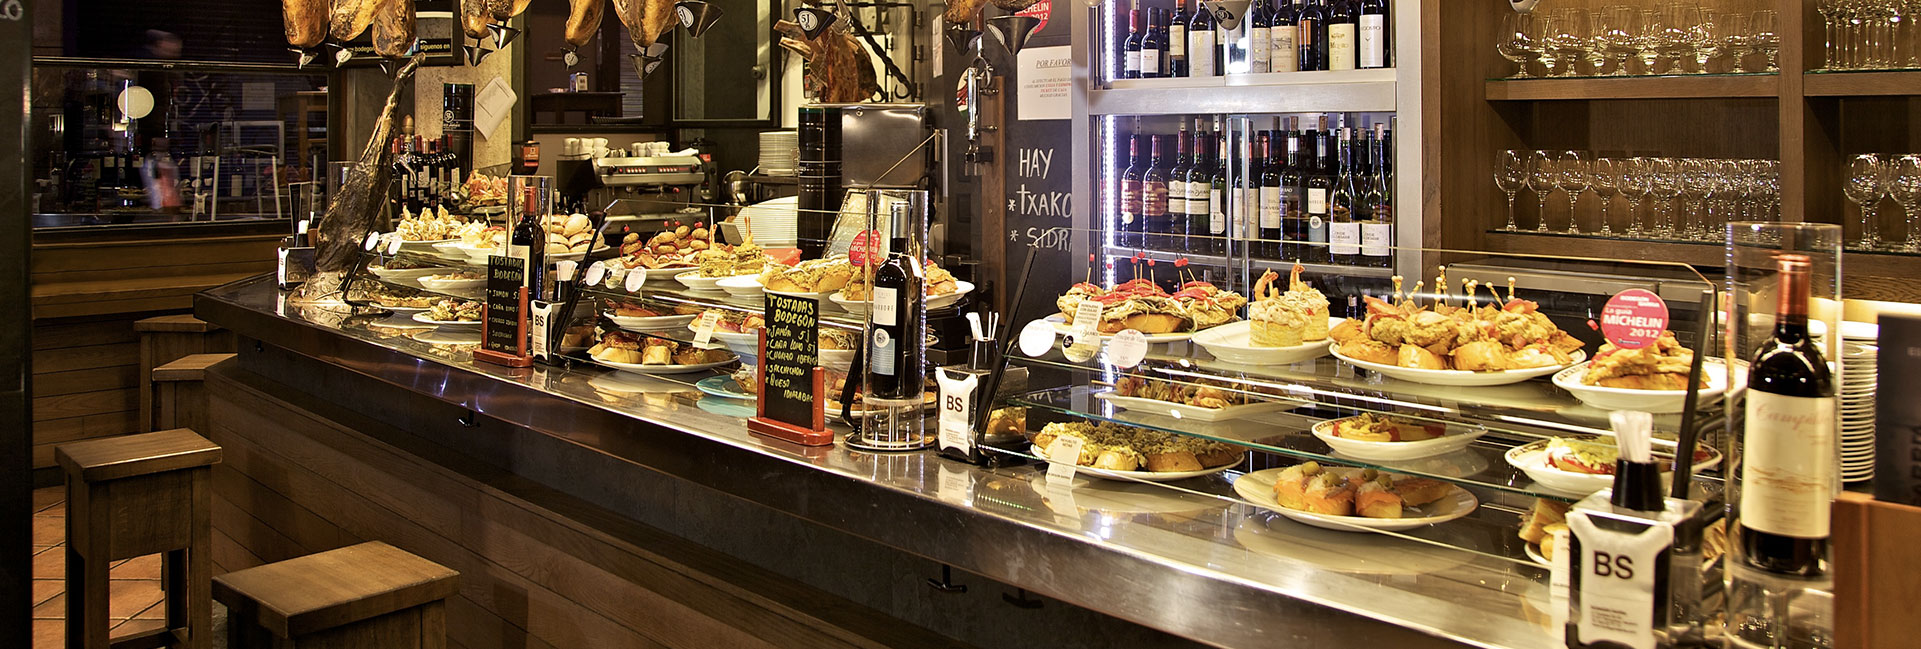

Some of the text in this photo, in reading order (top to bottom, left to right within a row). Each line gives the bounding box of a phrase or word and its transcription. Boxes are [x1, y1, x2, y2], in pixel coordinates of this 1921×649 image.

[1036, 59, 1049, 68] POR
[1019, 148, 1054, 180] HAY
[490, 256, 523, 269] TOSTADAS
[767, 294, 814, 316] TOSTADAS
[535, 315, 545, 327] BS
[774, 309, 816, 328] BODEGON
[1603, 314, 1663, 328] MICHELIN
[1629, 328, 1659, 338] 2012
[770, 373, 791, 388] QUESO
[946, 395, 963, 412] BS
[1594, 550, 1634, 580] BS
